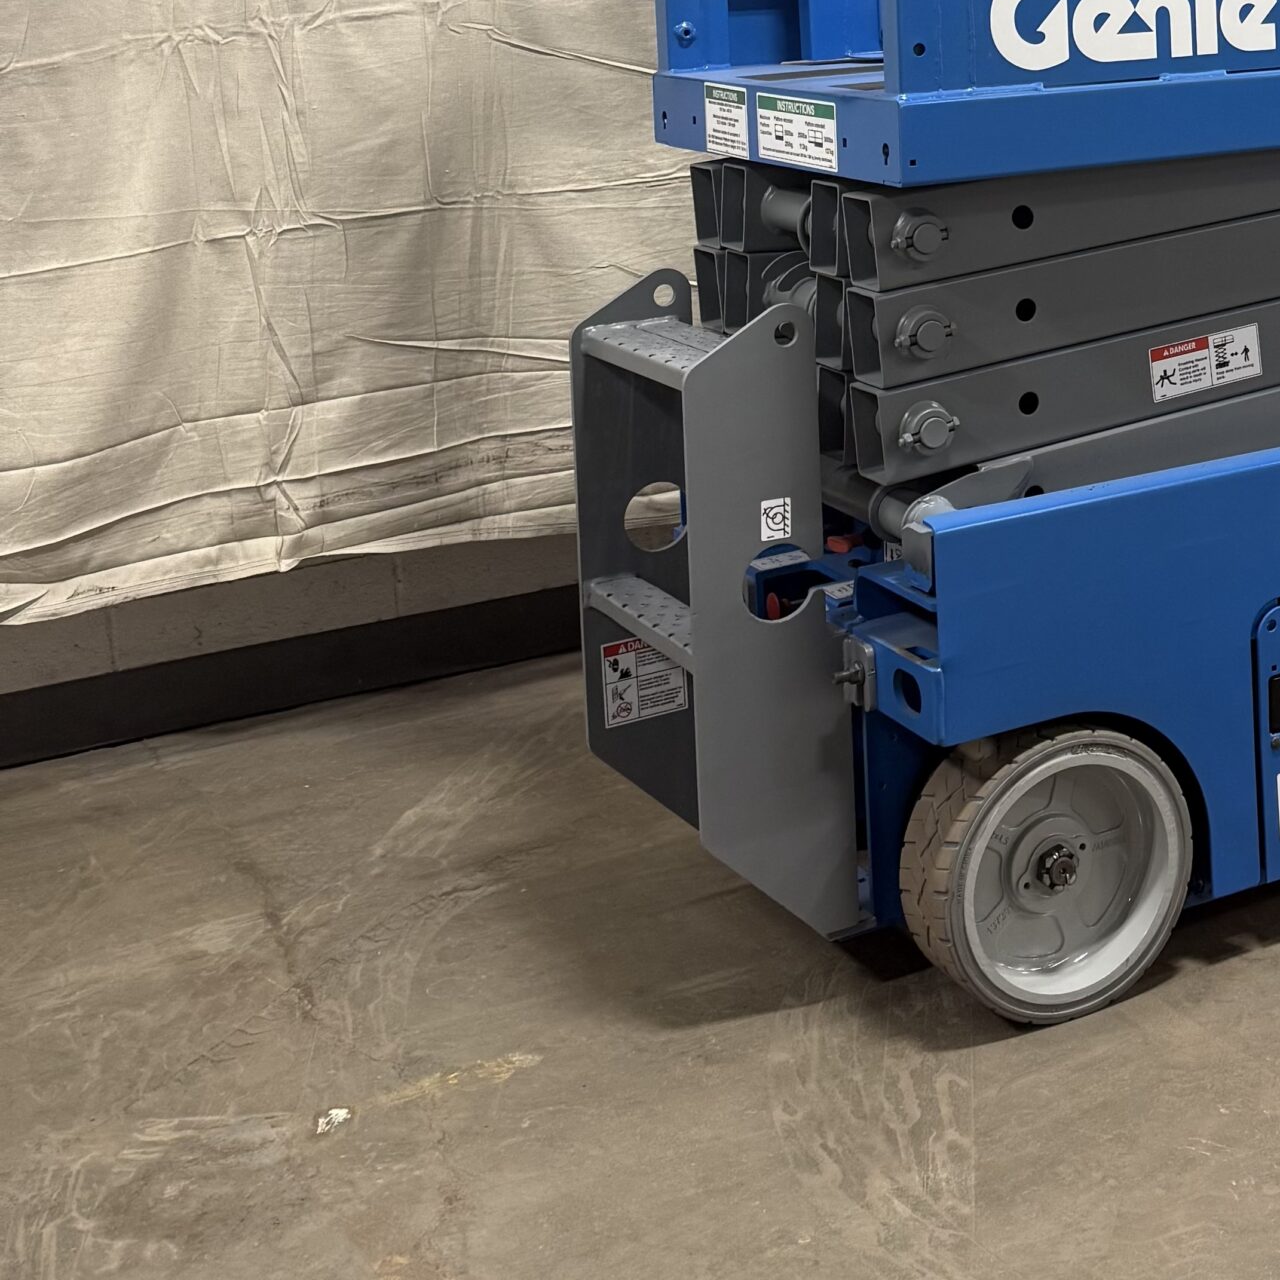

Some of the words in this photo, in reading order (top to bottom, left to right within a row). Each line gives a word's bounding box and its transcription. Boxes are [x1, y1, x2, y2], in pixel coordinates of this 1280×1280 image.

[712, 89, 738, 103] INSTRUCTIONS
[776, 100, 815, 116] INSTRUCTIONS
[1169, 342, 1196, 355] DANGER
